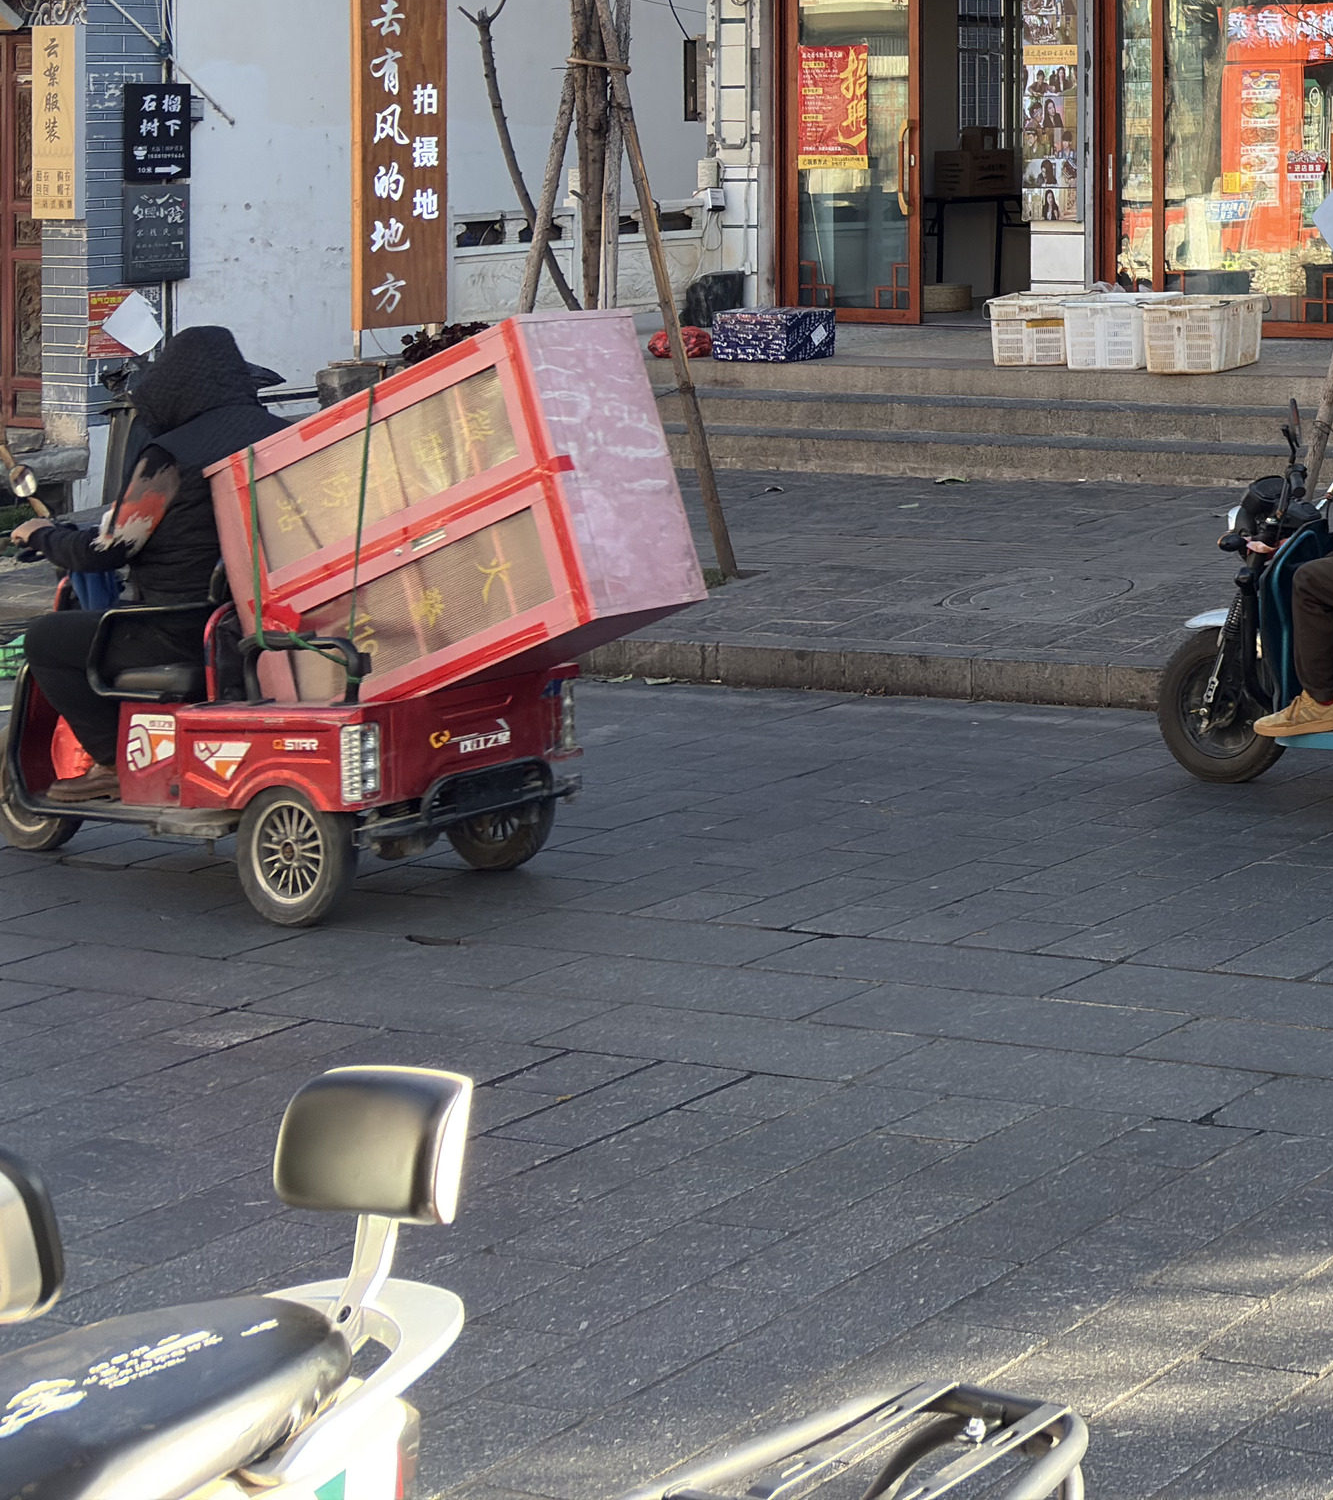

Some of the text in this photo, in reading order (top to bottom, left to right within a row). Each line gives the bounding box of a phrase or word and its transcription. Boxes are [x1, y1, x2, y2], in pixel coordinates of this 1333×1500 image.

[140, 94, 182, 113] 石榴
[837, 46, 867, 147] 招聘
[140, 118, 182, 137] 树下
[412, 83, 440, 221] 拍摄地
